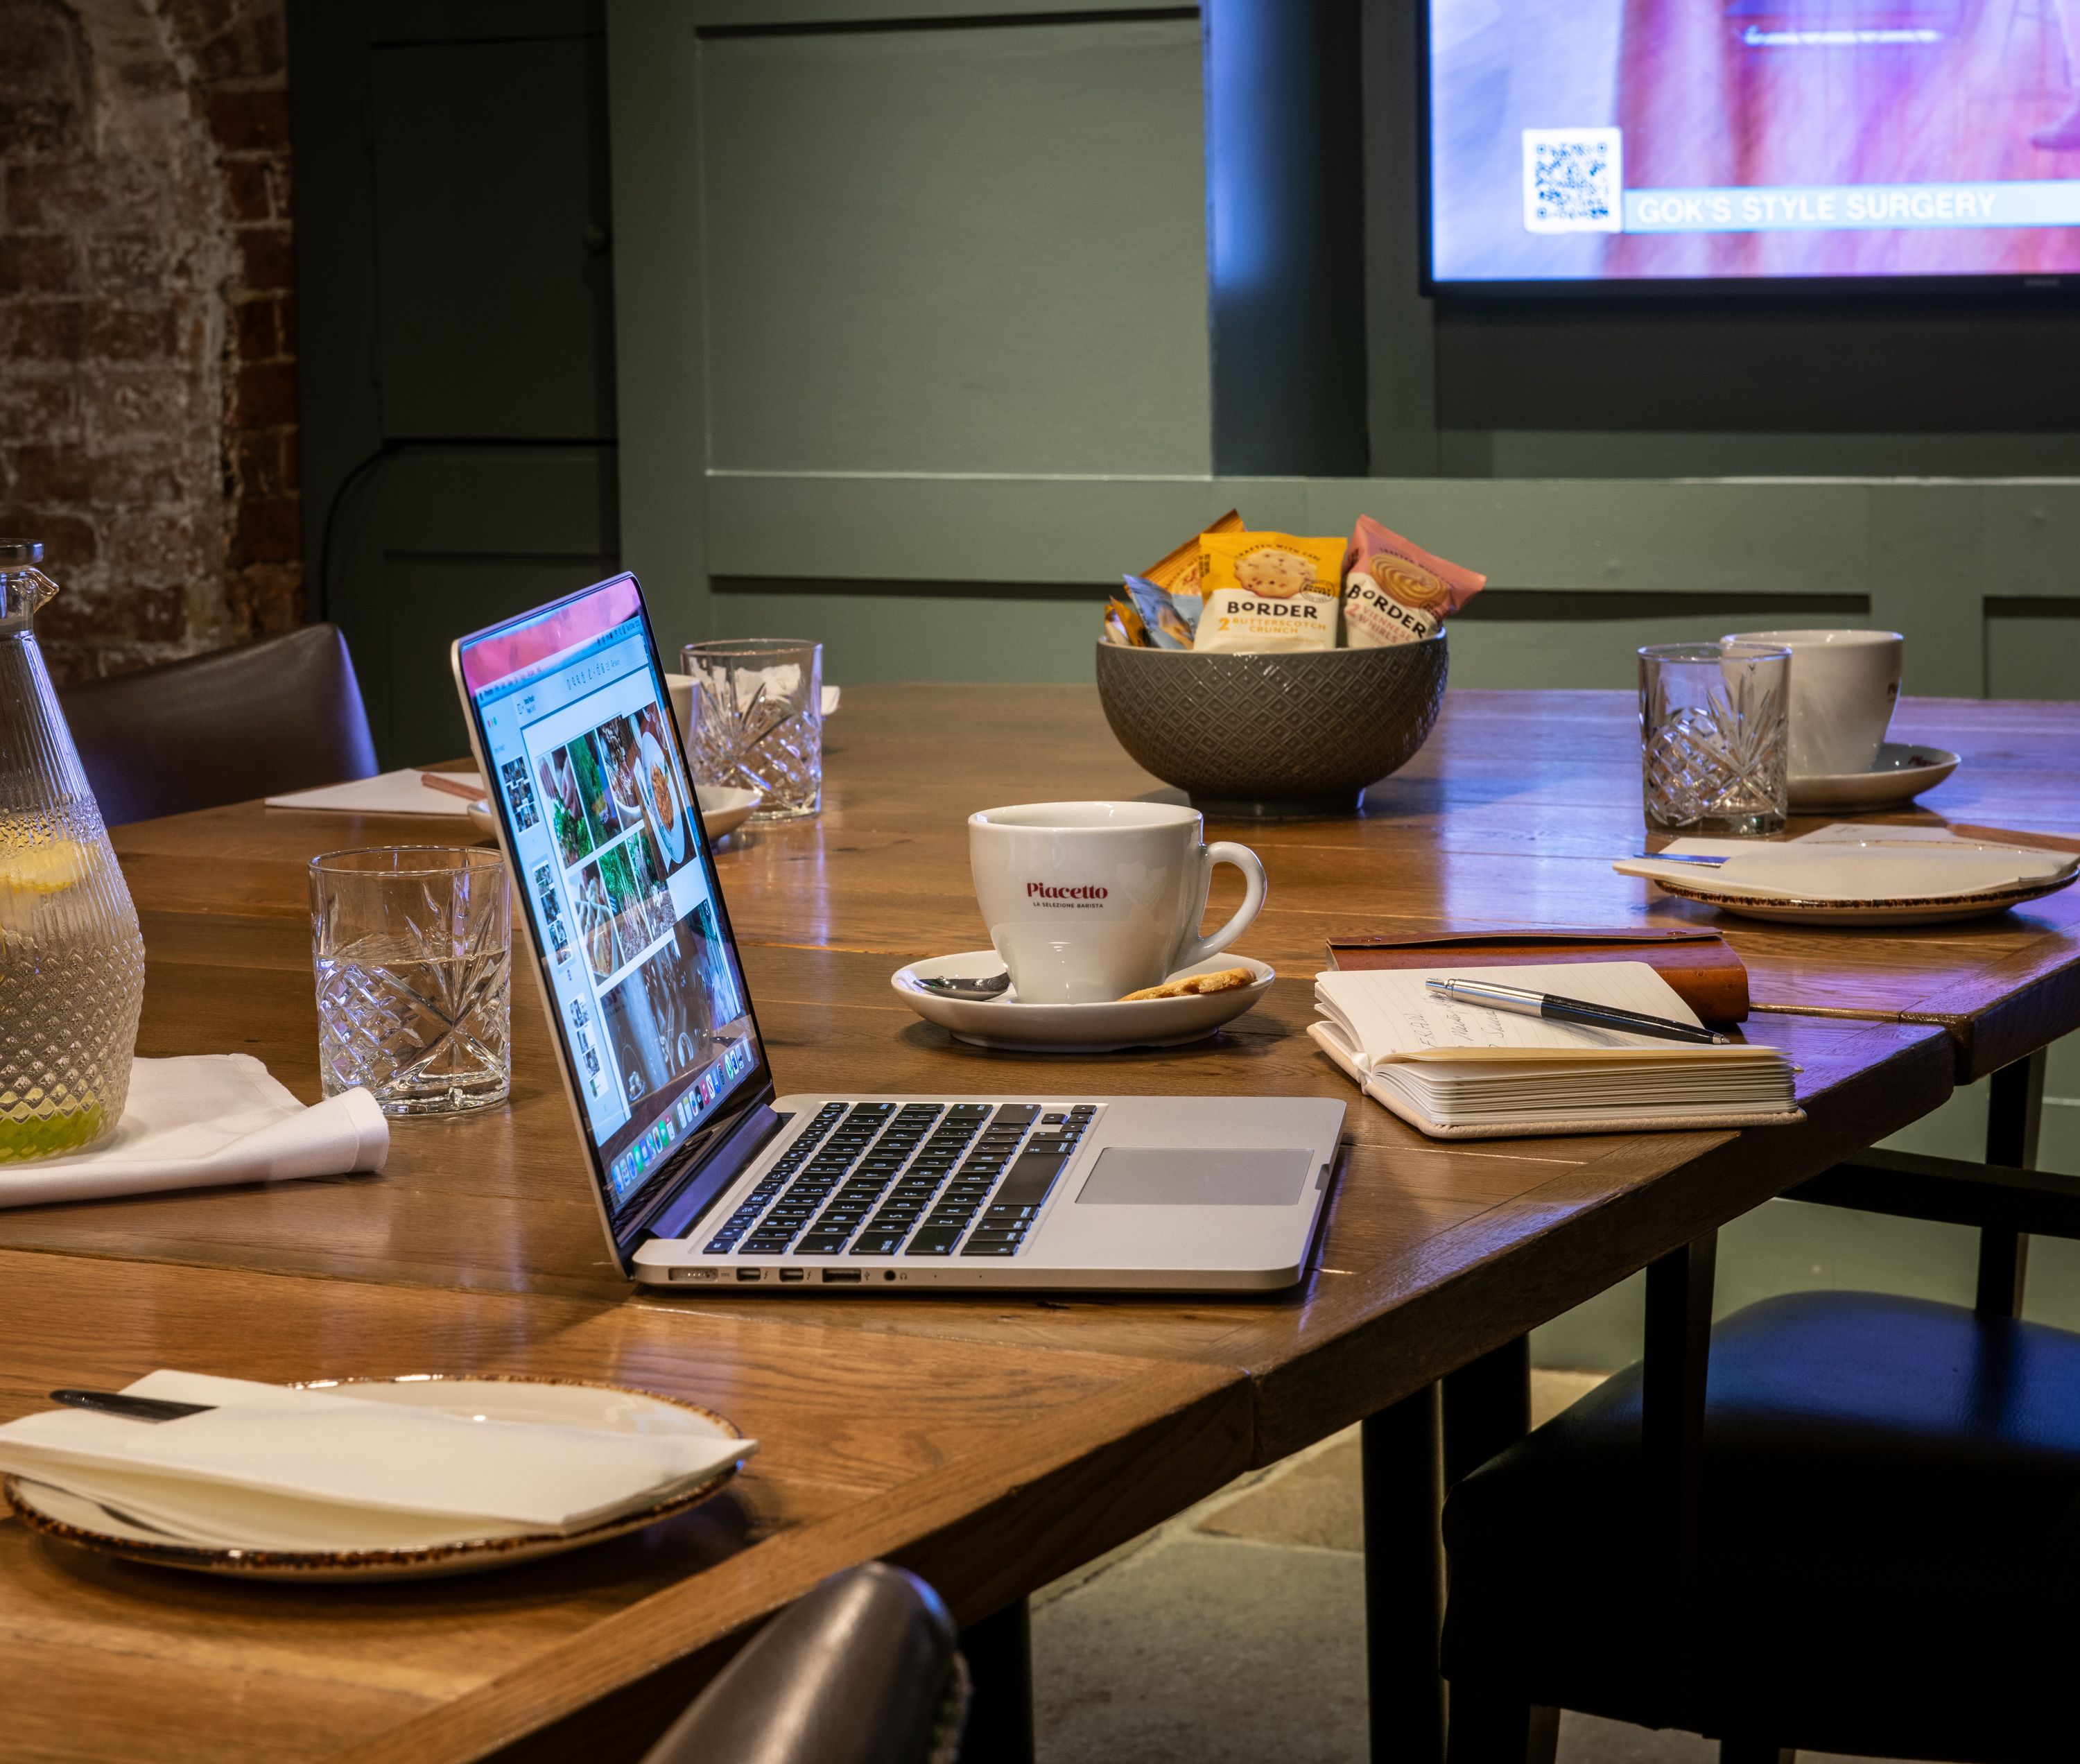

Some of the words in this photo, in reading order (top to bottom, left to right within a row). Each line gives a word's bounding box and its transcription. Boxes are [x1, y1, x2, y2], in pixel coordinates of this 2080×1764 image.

[1637, 195, 1732, 225] GOK'S
[1742, 193, 1836, 223] STYLE
[1845, 190, 1997, 221] SURGERY
[1227, 601, 1318, 619] BORDER
[1348, 584, 1427, 639] BORDER
[1218, 617, 1230, 631] 2
[1233, 618, 1326, 630] BUTTERSCOTCH
[1249, 625, 1299, 634] CRUNCH
[1345, 603, 1360, 619] 2
[1363, 606, 1414, 643] VIENNESE
[1358, 614, 1398, 644] WHIRLS
[1027, 882, 1108, 899] Piacetto
